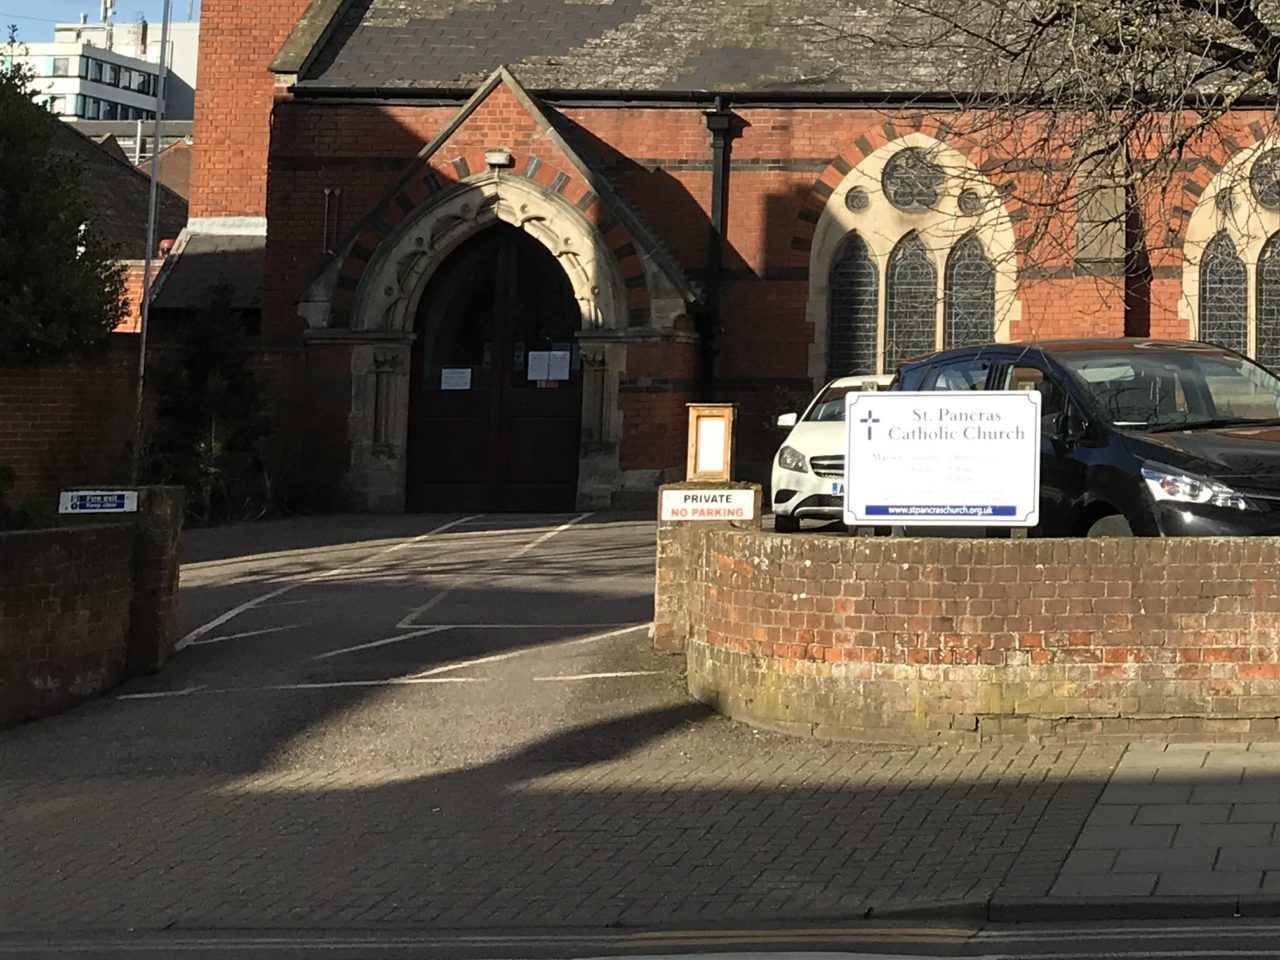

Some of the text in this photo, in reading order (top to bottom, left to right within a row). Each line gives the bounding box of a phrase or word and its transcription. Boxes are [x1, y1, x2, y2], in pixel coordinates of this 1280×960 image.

[912, 407, 1002, 422] St. Pancras
[888, 425, 1025, 441] Catholic Church
[683, 494, 733, 504] PRIVATE
[671, 507, 744, 517] NO PARKING
[888, 506, 993, 516] www.stpancraschurch.org.uk
